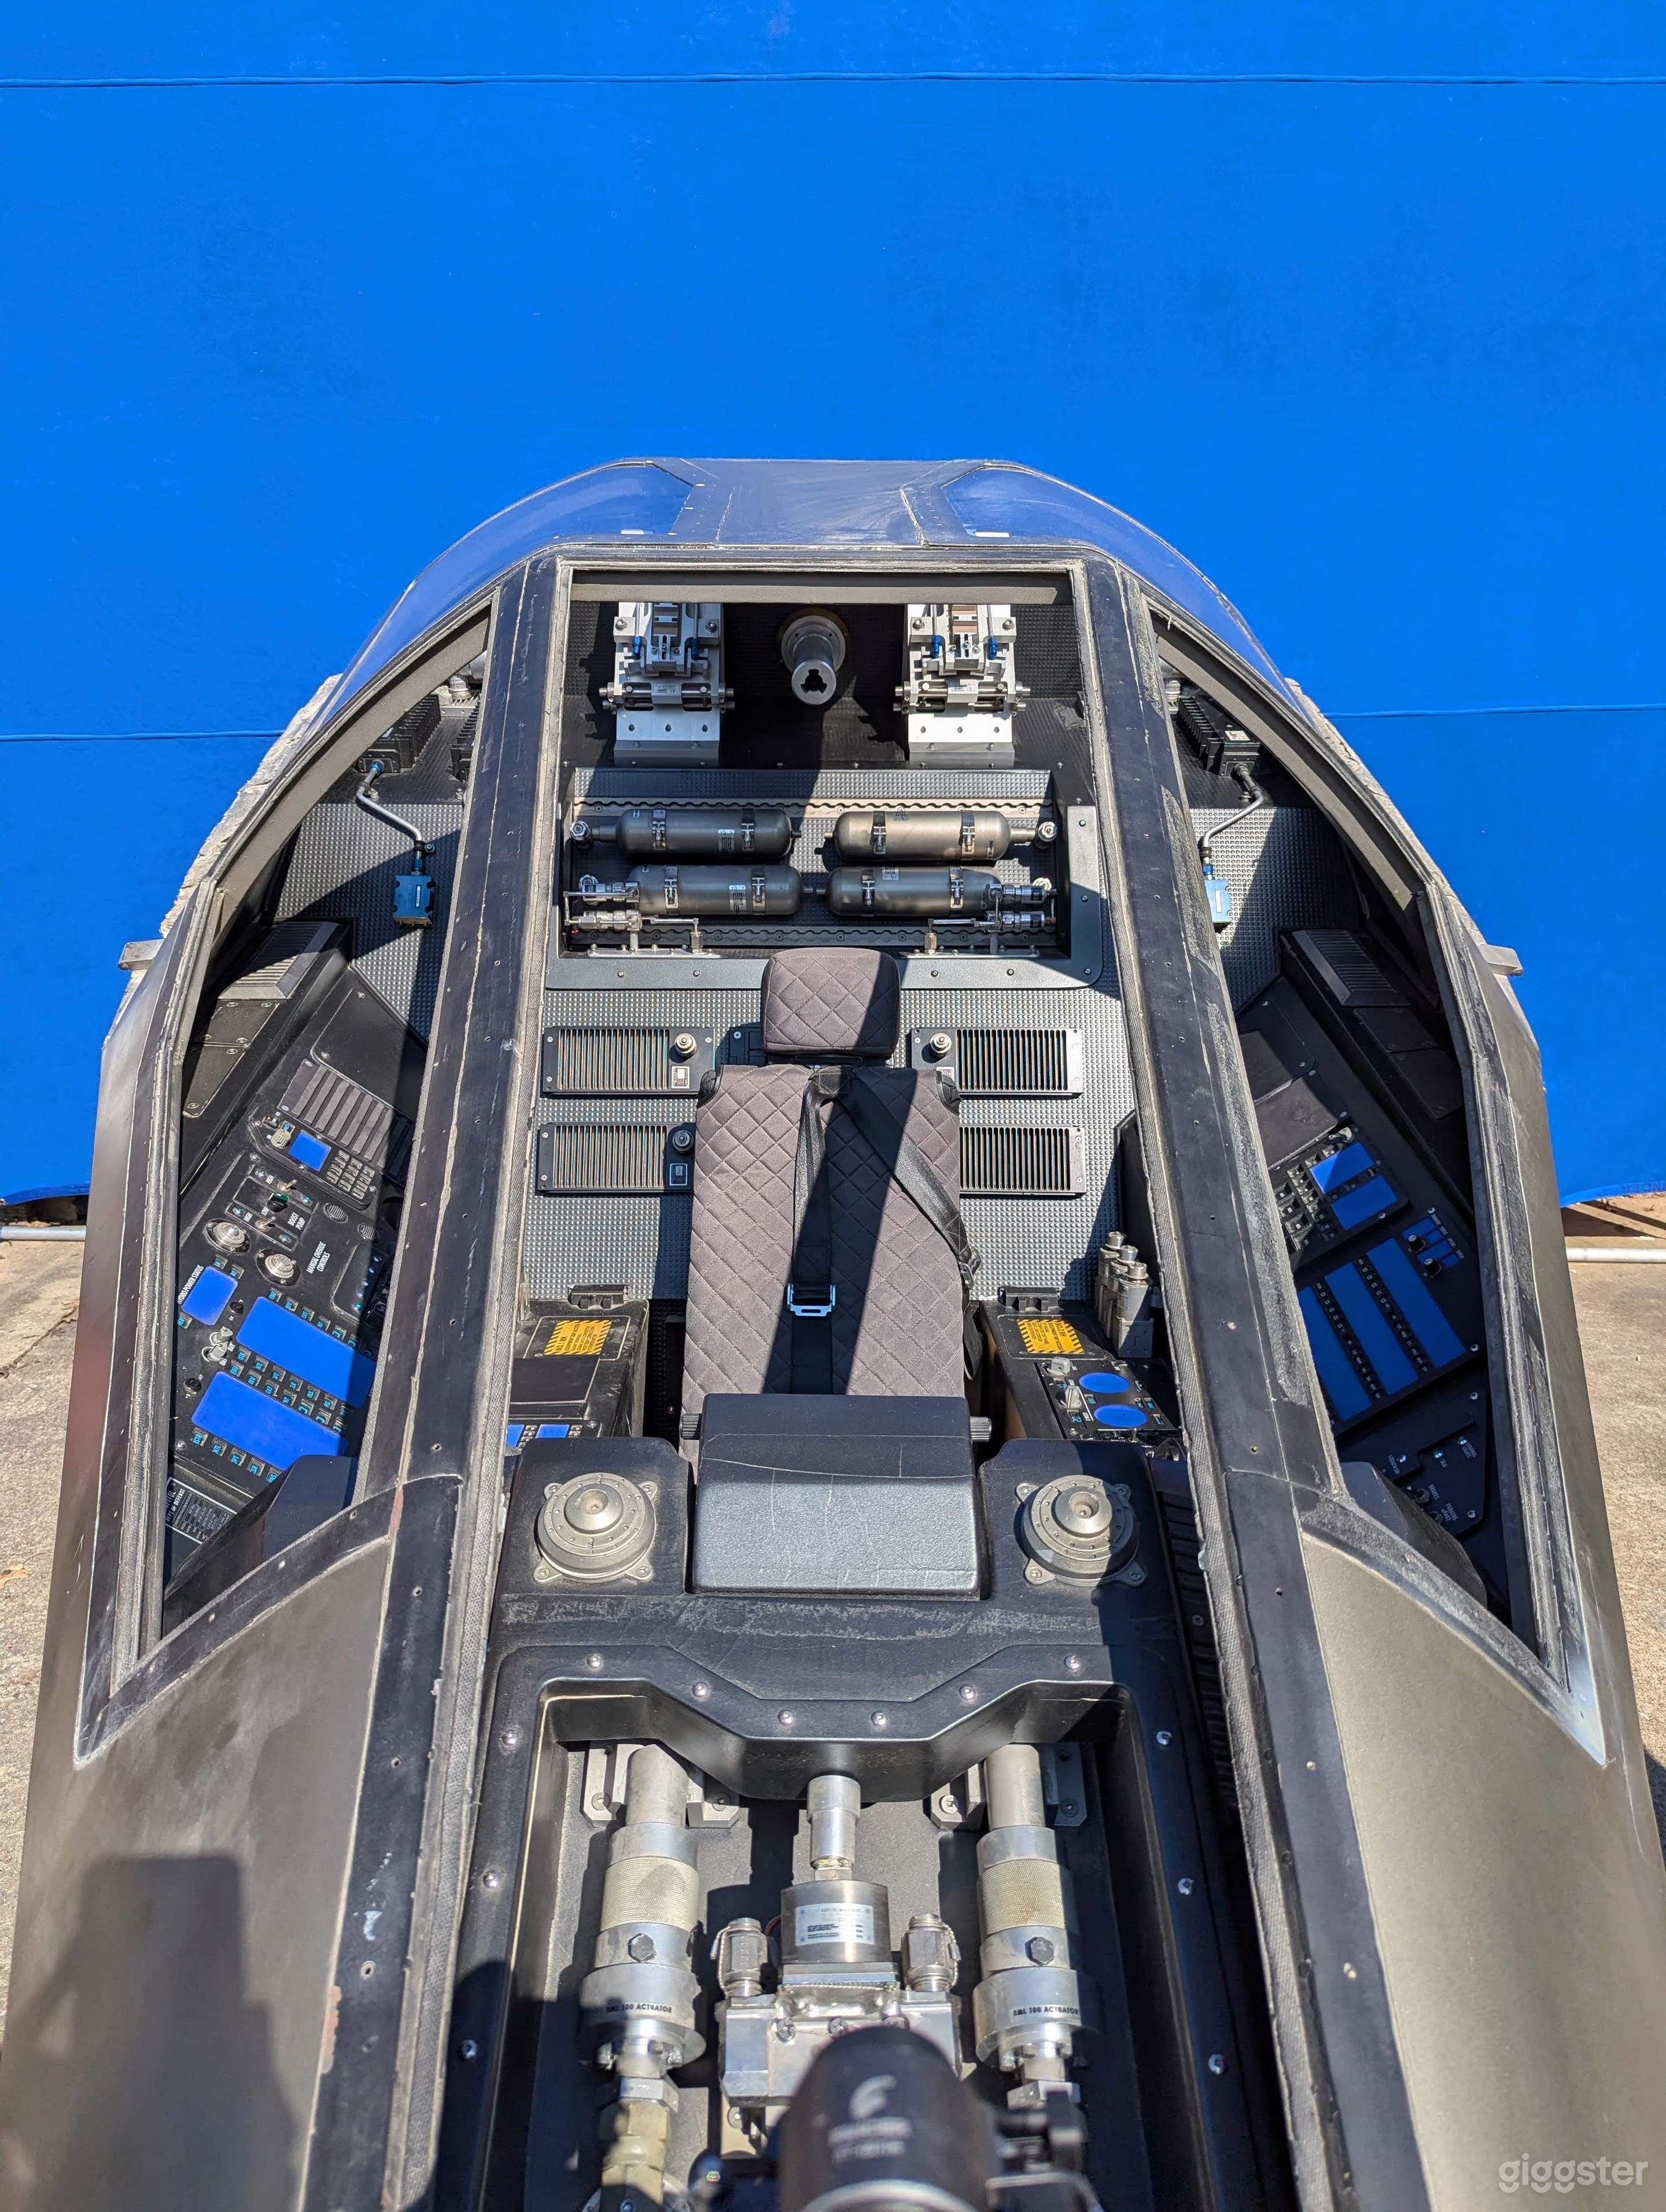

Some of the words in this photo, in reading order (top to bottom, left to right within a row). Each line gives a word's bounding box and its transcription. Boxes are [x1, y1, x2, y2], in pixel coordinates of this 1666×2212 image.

[288, 1212, 299, 1226] BOOST
[295, 1217, 305, 1230] PUMP
[306, 1256, 319, 1273] MANUAL
[316, 1251, 330, 1272] CONTROLS
[183, 1276, 196, 1292] POWER
[191, 1264, 204, 1279] STATUS
[173, 1487, 186, 1505] DEFENSE
[636, 2003, 672, 2013] ACTUATOR
[1044, 2006, 1079, 2015] ACTUATOR
